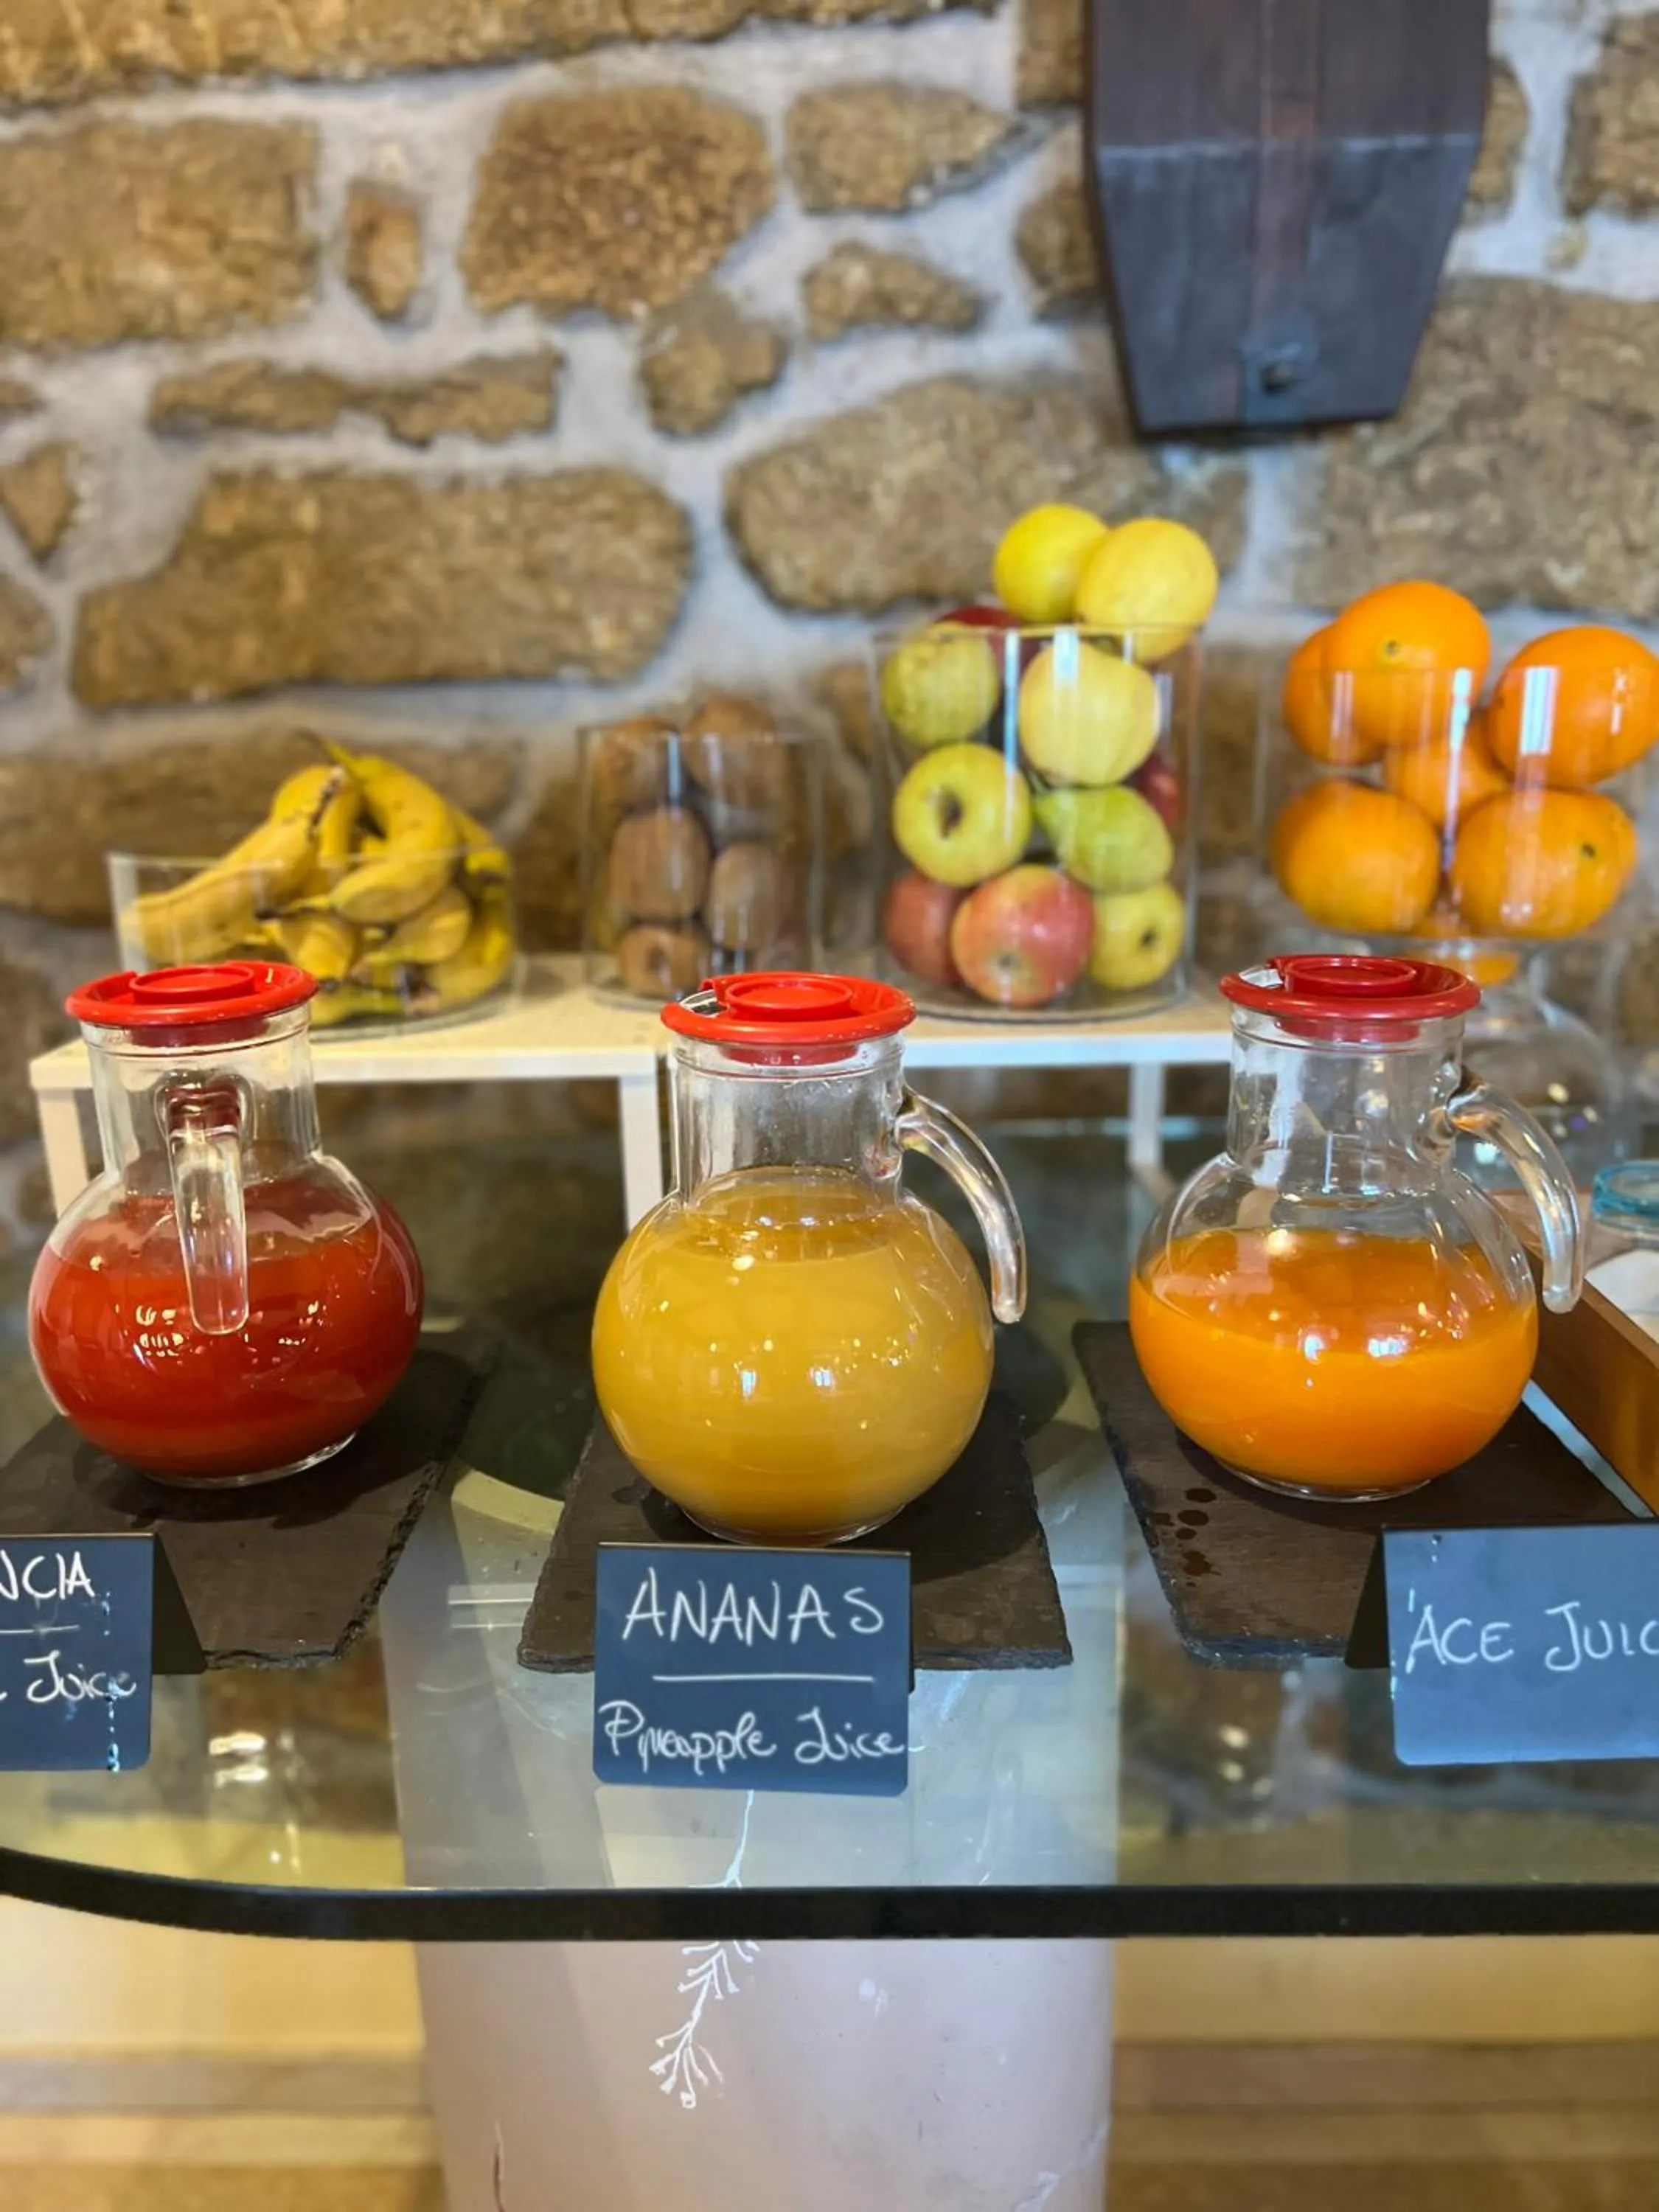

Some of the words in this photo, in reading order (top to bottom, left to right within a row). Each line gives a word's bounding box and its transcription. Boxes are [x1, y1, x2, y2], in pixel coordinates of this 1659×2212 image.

[622, 1567, 884, 1646] ANANAS
[1405, 1604, 1514, 1674] ACE
[794, 1707, 905, 1764] Juice
